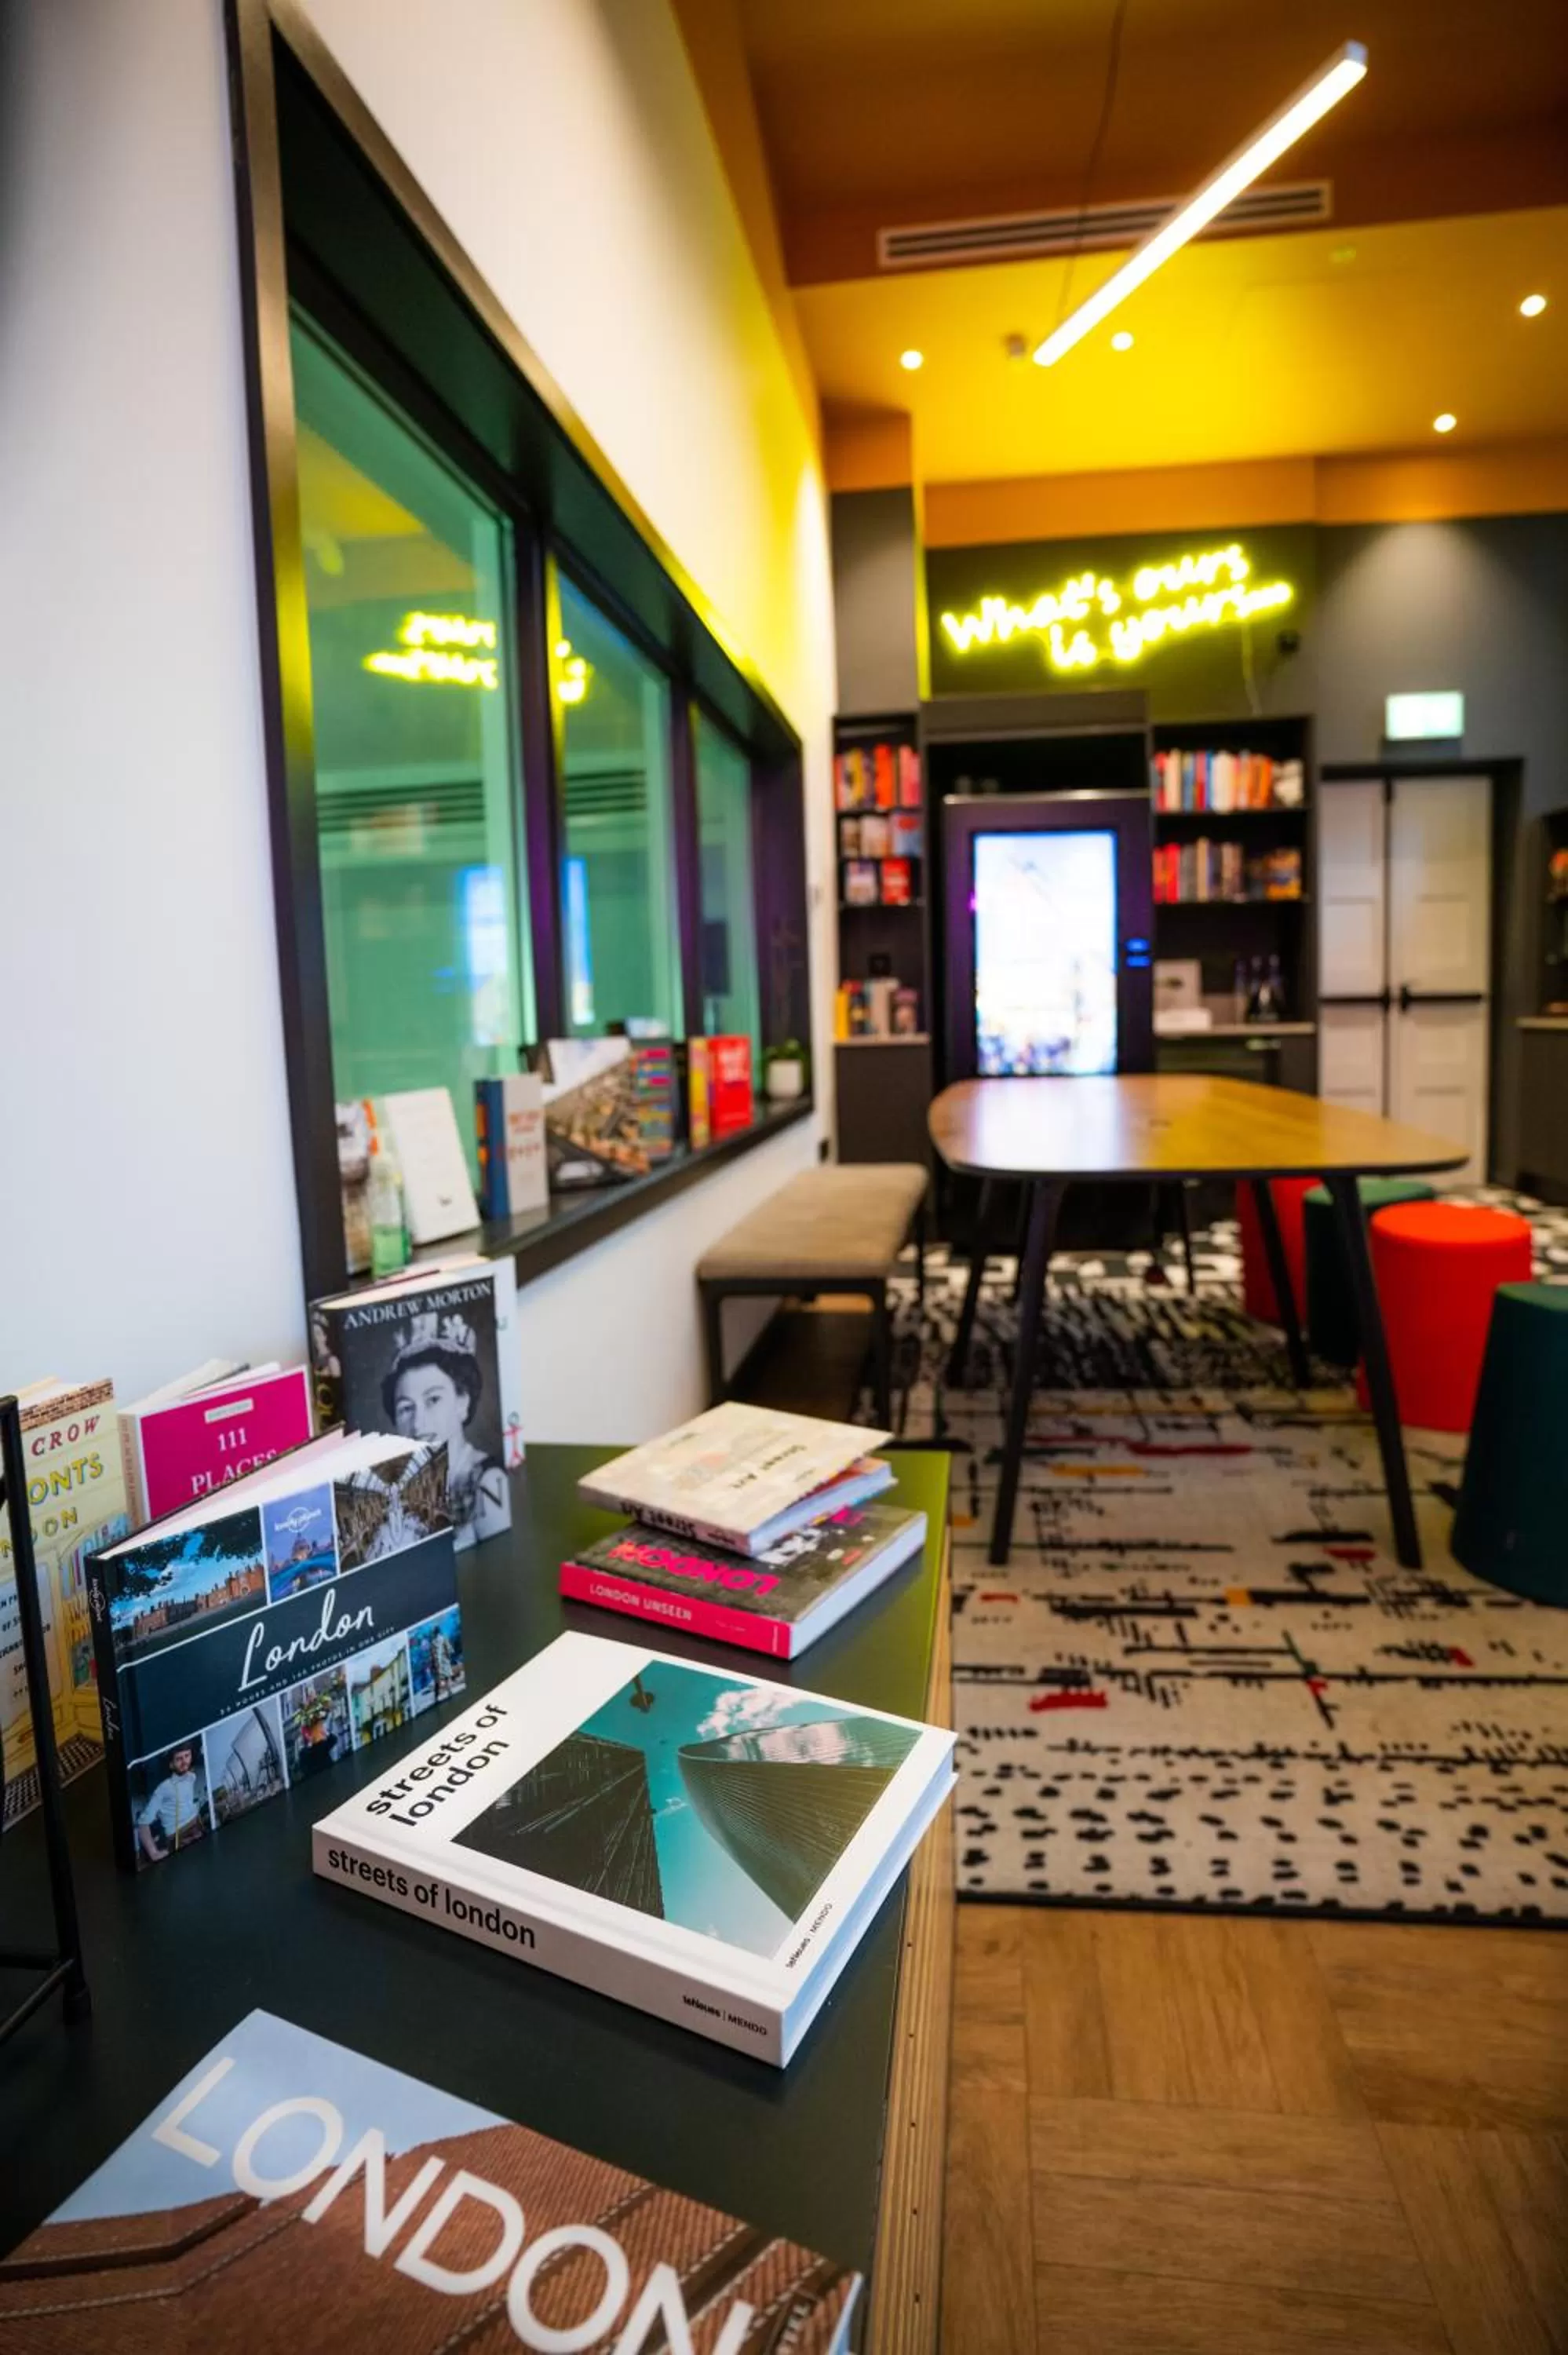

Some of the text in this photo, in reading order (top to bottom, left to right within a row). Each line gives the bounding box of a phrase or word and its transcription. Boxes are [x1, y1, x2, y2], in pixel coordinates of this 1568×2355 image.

[345, 1281, 492, 1330] ANDREW MORTON
[31, 1415, 100, 1456] CROW
[217, 1427, 247, 1451] 111
[27, 1451, 104, 1505] ONTS
[589, 1583, 691, 1620] LONDON UNSEEN
[238, 1588, 374, 1692] London
[365, 1703, 509, 1816] streets of
[388, 1739, 511, 1827] london
[328, 1848, 536, 1949] streets of london
[727, 2014, 768, 2036] MENDO
[151, 2056, 754, 2355] LONDON
